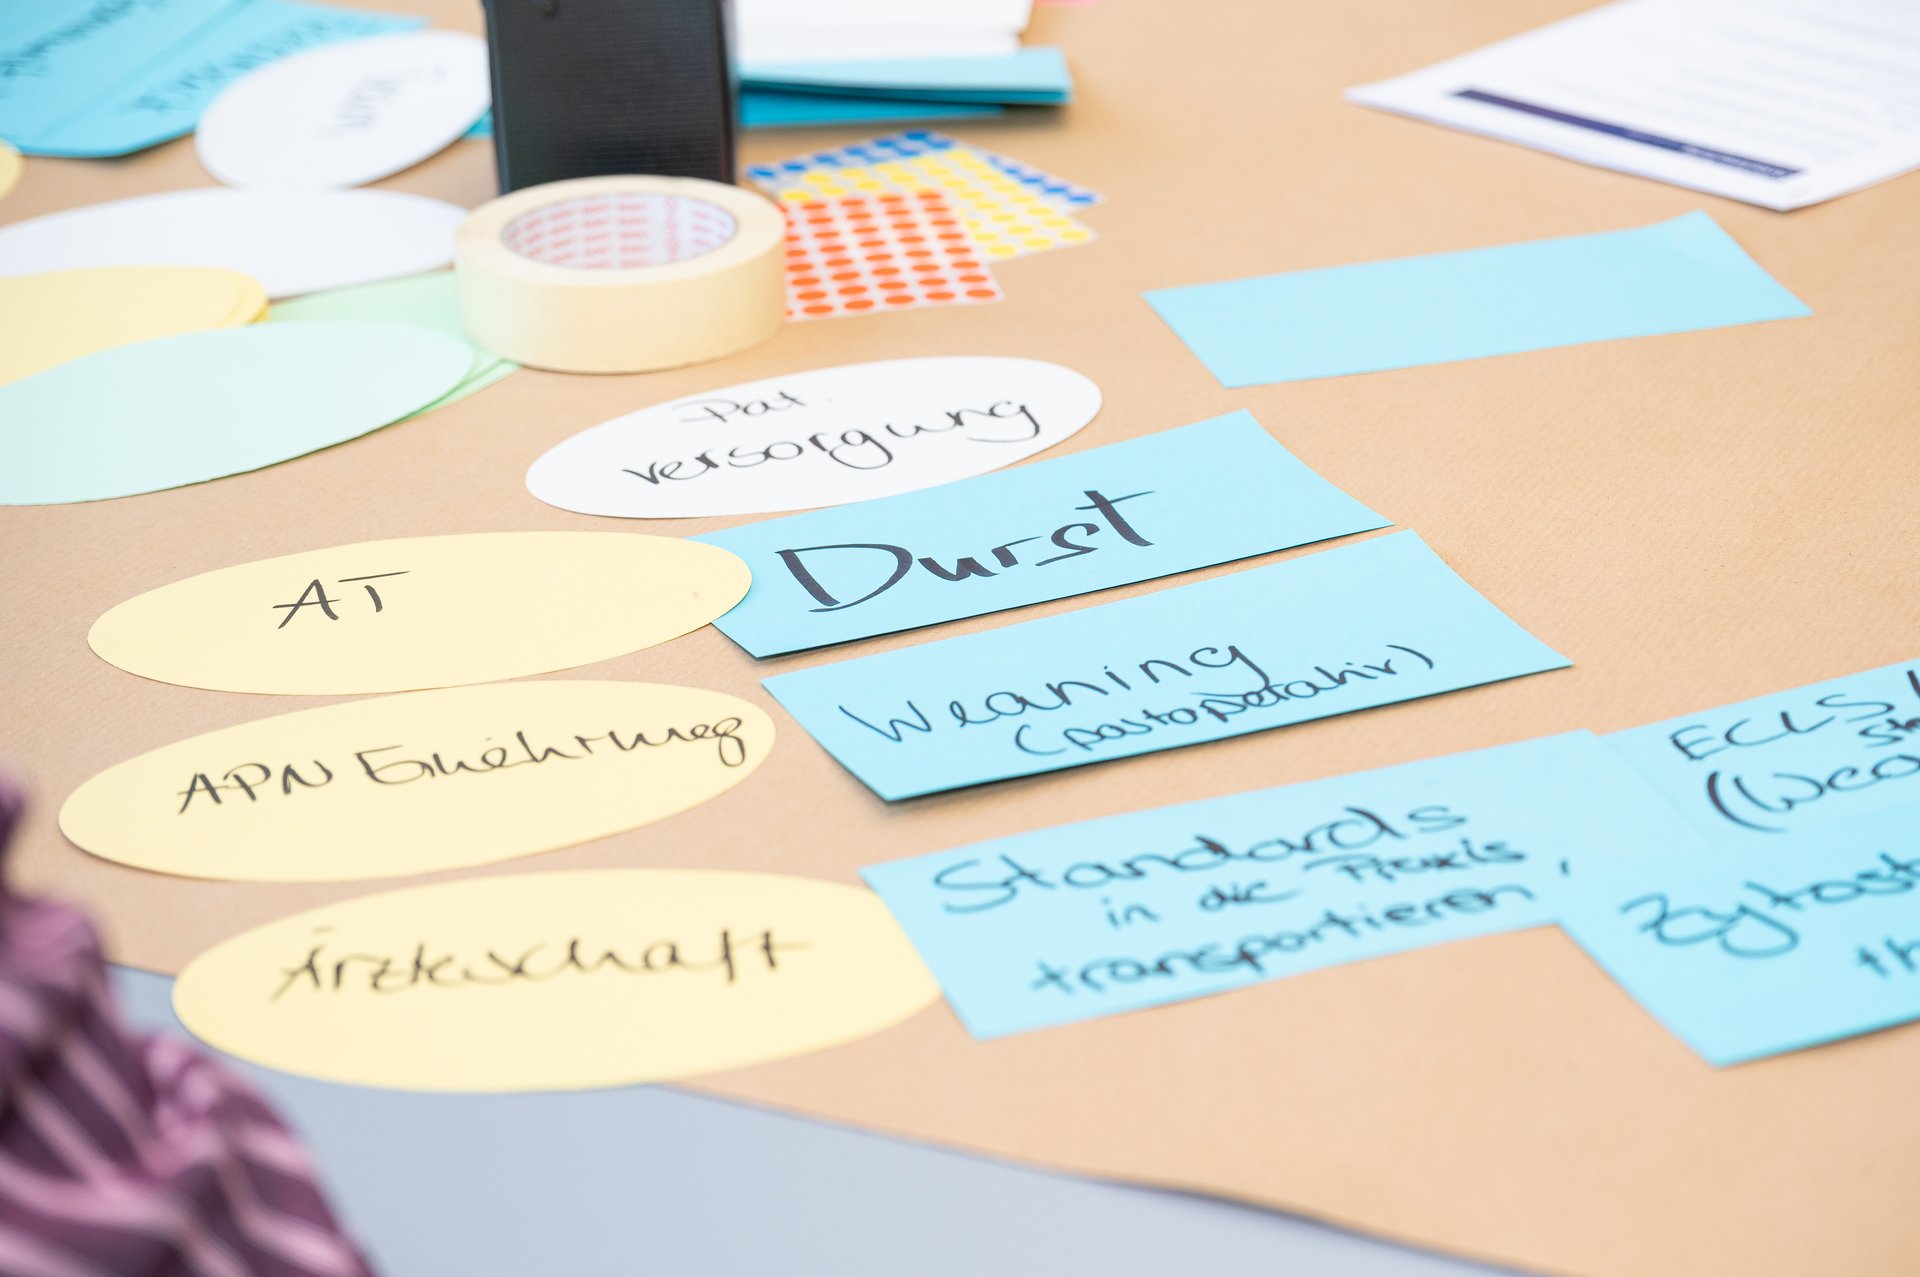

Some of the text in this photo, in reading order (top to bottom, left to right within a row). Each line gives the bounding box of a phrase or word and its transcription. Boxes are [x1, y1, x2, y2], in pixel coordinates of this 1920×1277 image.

[775, 489, 1155, 612] Durst
[272, 570, 411, 629] AT
[839, 645, 1270, 743] Weaning
[1668, 693, 1896, 761] ECLS
[177, 758, 335, 815] APN
[934, 806, 1468, 914] Standards
[1102, 838, 1527, 929] in die Praxis
[1029, 883, 1536, 994] transportieren
